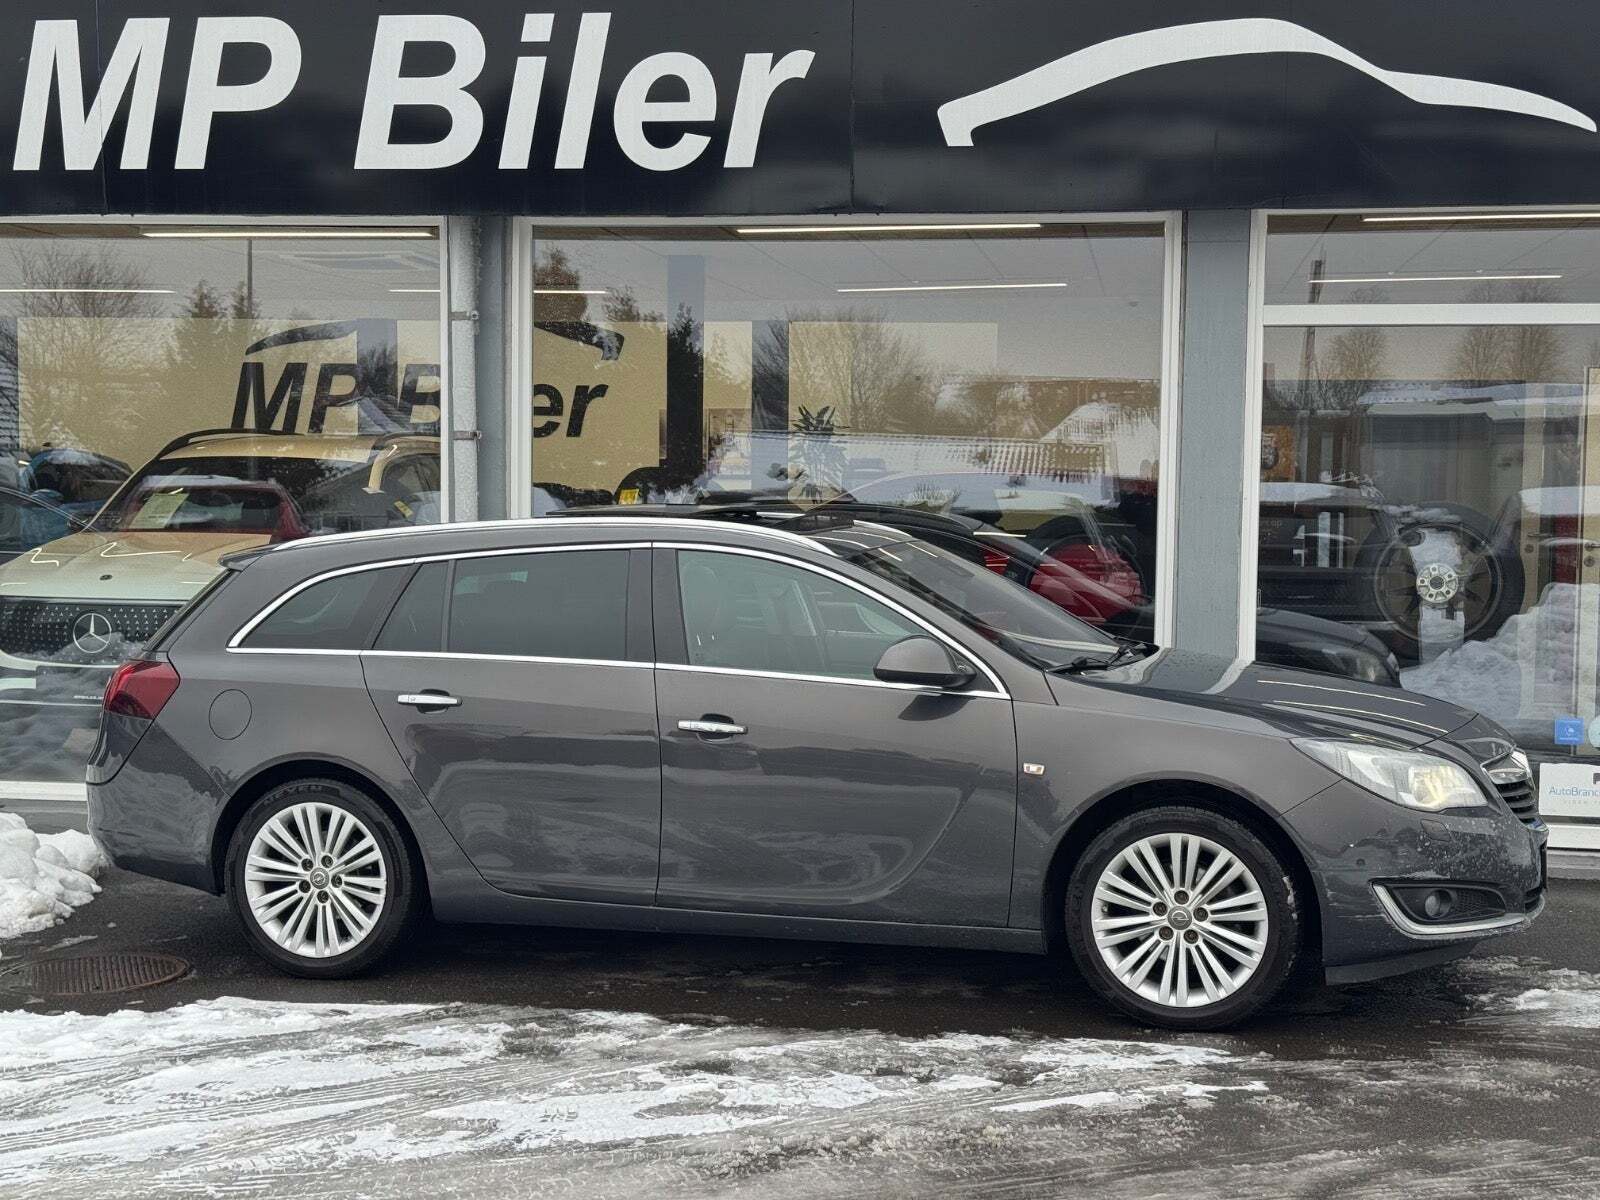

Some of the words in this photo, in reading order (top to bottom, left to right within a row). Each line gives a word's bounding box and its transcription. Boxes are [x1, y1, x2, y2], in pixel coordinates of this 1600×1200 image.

[13, 16, 302, 171] MP
[354, 12, 816, 172] Biler
[231, 361, 363, 434] MP
